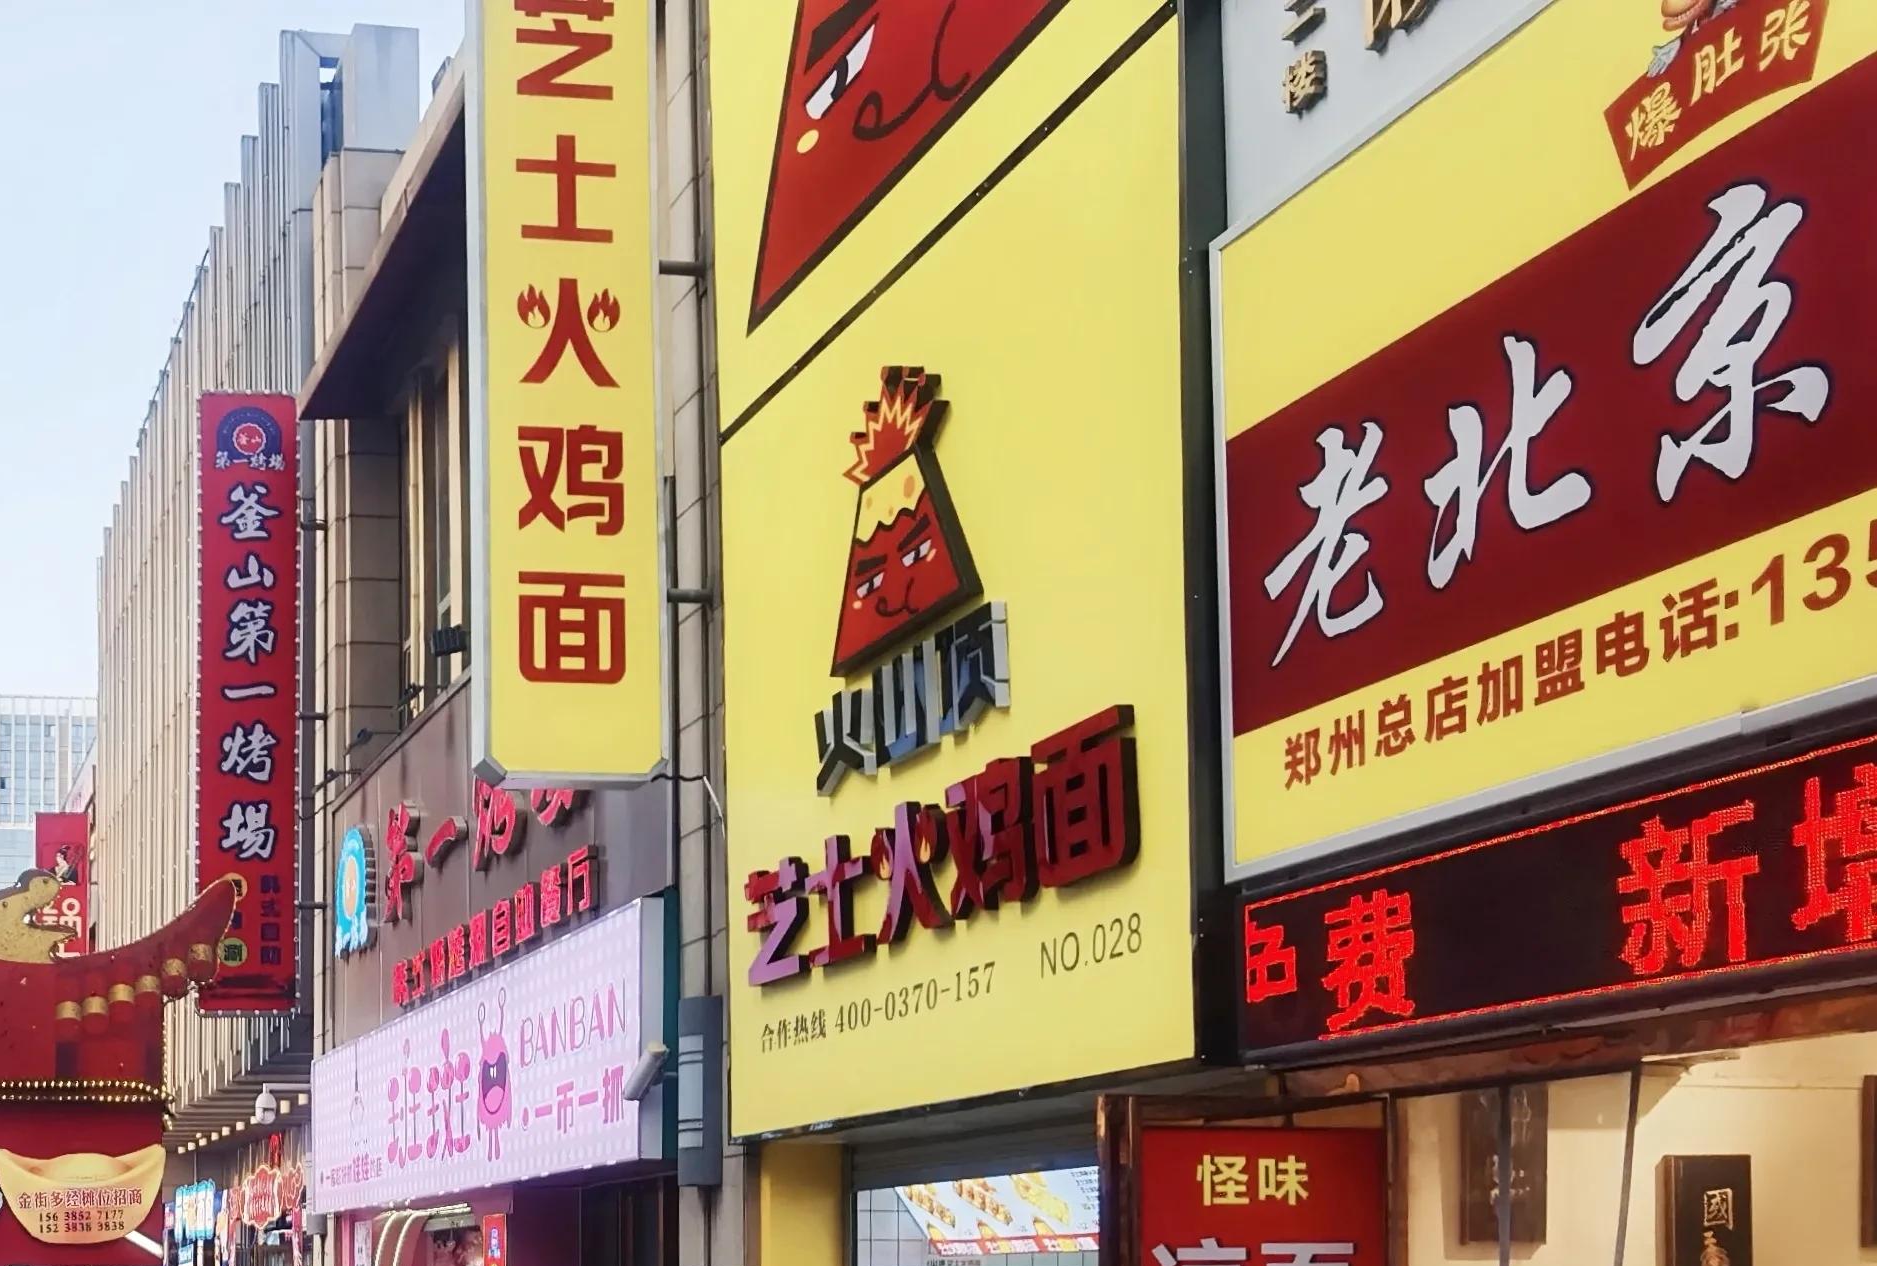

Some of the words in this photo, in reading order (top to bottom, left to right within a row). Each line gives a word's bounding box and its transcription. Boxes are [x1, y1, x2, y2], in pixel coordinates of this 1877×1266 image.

[1623, 0, 1813, 161] 爆肚张
[513, 0, 626, 684] 芝士火鸡面
[1263, 183, 1829, 667] 老北京
[743, 704, 1141, 987] 芝士火鸡面
[760, 1008, 827, 1054] 合作热线
[834, 960, 996, 1034] 400-0370-157
[1039, 912, 1143, 979] NO.028
[519, 978, 628, 1069] BANBAN
[1196, 1154, 1310, 1206] 怪味
